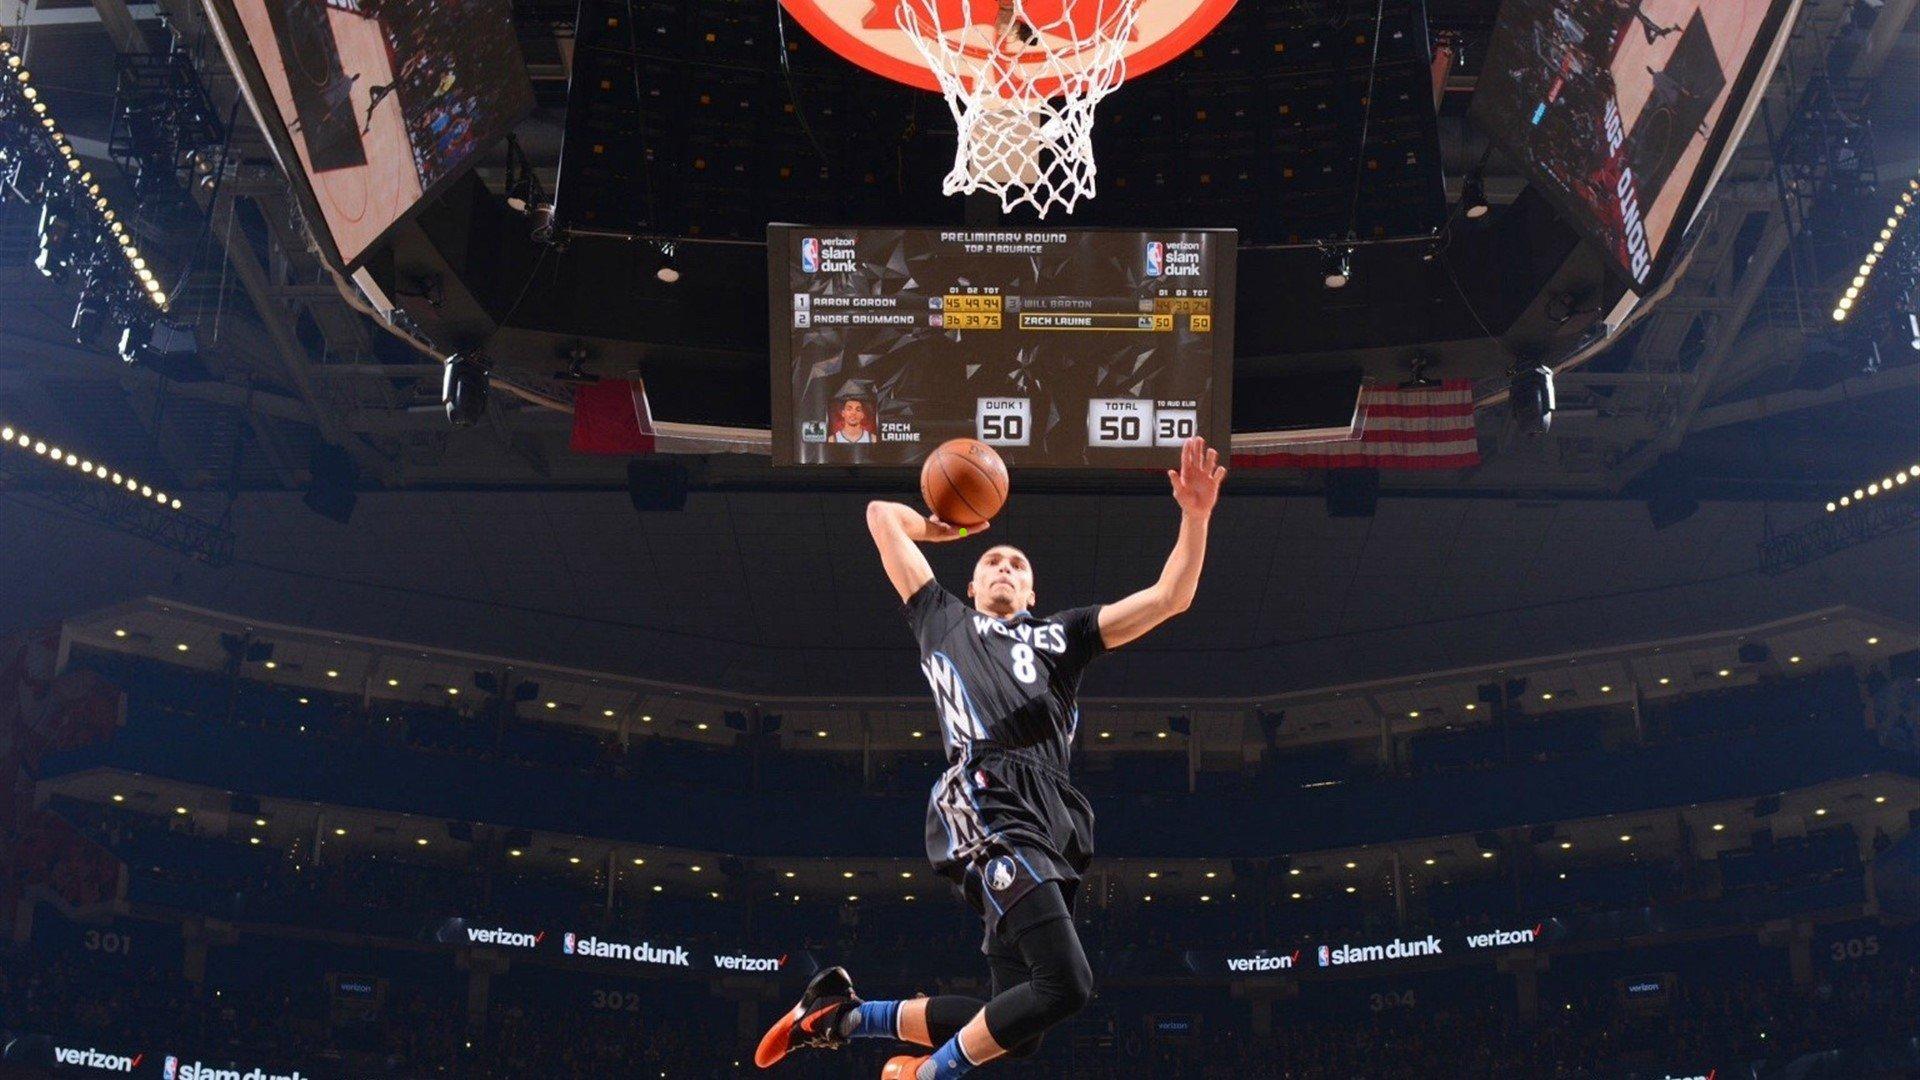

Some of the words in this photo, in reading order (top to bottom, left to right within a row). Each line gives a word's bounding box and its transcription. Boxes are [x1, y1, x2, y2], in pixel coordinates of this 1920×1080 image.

[821, 237, 855, 246] verizon
[941, 232, 1021, 242] PRELIMINARY
[1025, 233, 1067, 243] ROUND
[965, 245, 984, 253] TOP
[987, 245, 993, 253] 2
[995, 245, 1042, 253] ADVANCE
[1166, 241, 1199, 250] verizon
[821, 246, 855, 259] slam
[1166, 250, 1199, 263] slam
[821, 259, 857, 272] dunk
[1165, 263, 1200, 276] dunk
[800, 297, 804, 307] 1
[813, 298, 850, 307] AARON
[853, 298, 896, 307] GORDON
[946, 299, 960, 308] 45
[965, 299, 980, 308] 49
[984, 299, 998, 308] 94
[1024, 299, 1047, 308] WILL
[1050, 299, 1092, 308] BARTON
[799, 314, 806, 324] 2
[813, 315, 849, 324] ANDRE
[852, 315, 914, 324] DRUMMOND
[946, 315, 960, 325] 36
[966, 315, 980, 325] 39
[984, 315, 998, 325] 75
[1024, 316, 1052, 326] ZACH
[1156, 318, 1169, 327] 50
[1193, 318, 1208, 327] 50
[986, 401, 1015, 409] DUNK
[1105, 402, 1138, 411] TOTAL
[881, 423, 911, 432] ZACH
[983, 415, 1023, 440] 50
[1100, 416, 1140, 441] 50
[1159, 418, 1193, 438] 30
[973, 615, 1067, 654] WOLVES
[1010, 643, 1037, 684] 8
[84, 929, 131, 955] 301
[1830, 935, 1880, 961] 305
[467, 927, 536, 948] verizon
[577, 936, 631, 960] slam
[633, 942, 689, 967] dunk
[714, 954, 779, 971] verizon
[1227, 954, 1292, 971] verizon
[1331, 944, 1385, 966] slam
[1385, 935, 1442, 960] dunk
[1466, 928, 1534, 949] verizon
[341, 983, 371, 993] verizon
[1628, 982, 1659, 992] verizon
[592, 990, 640, 1011] 302
[1369, 989, 1416, 1012] 304
[55, 1047, 132, 1072] verizon
